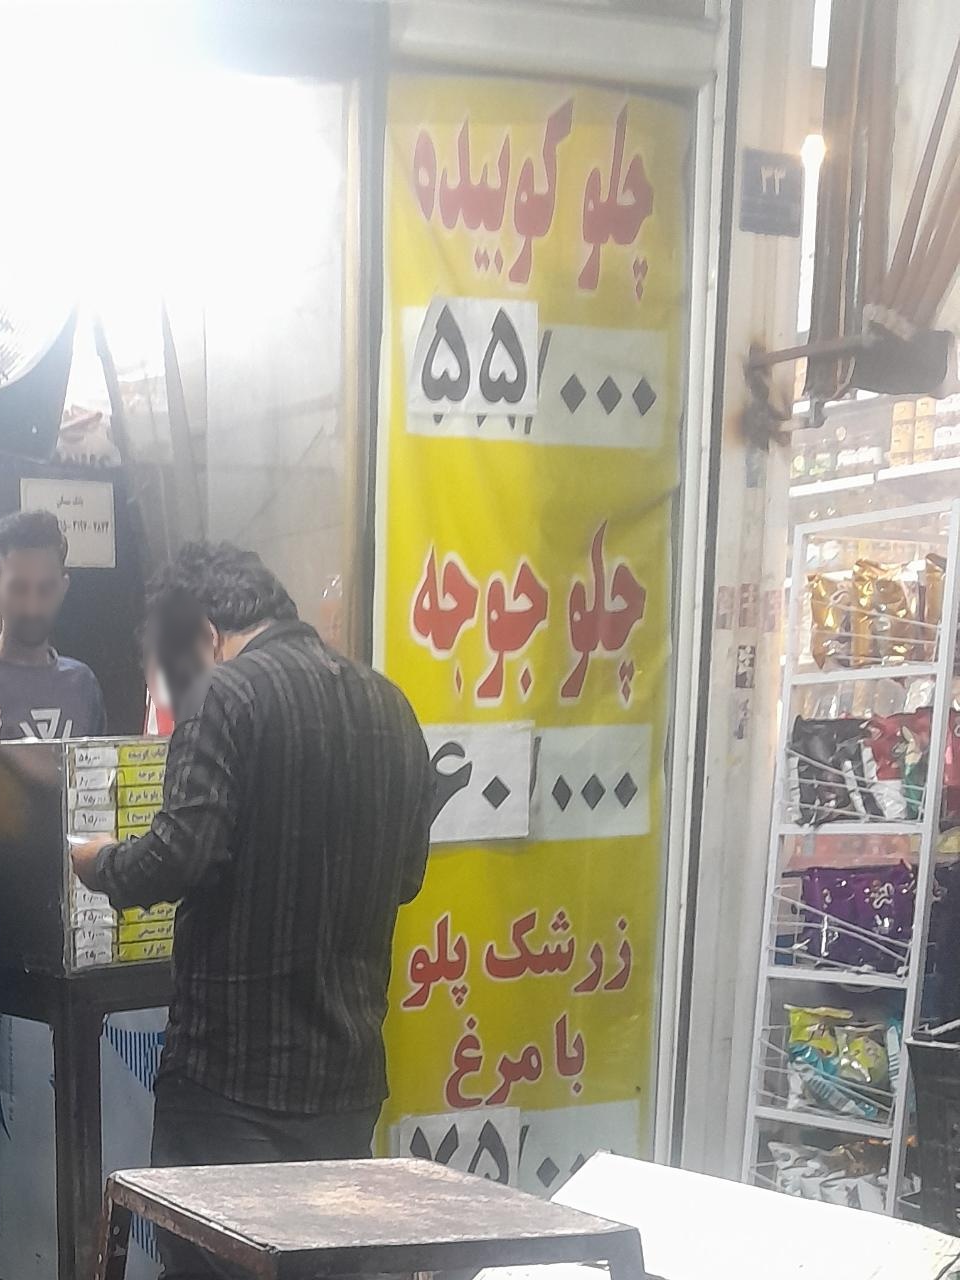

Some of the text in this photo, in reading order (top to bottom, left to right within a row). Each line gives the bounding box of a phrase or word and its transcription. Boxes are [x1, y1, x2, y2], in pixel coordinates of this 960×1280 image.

[413, 98, 654, 302] چلو کوبیده
[421, 304, 658, 416] ۵۵/۰۰۰
[413, 521, 646, 701] چلو جوجه
[402, 907, 633, 1009] زرشک پلو
[445, 1014, 586, 1107] با مرغ
[409, 1118, 616, 1188] ۷۵/۰
